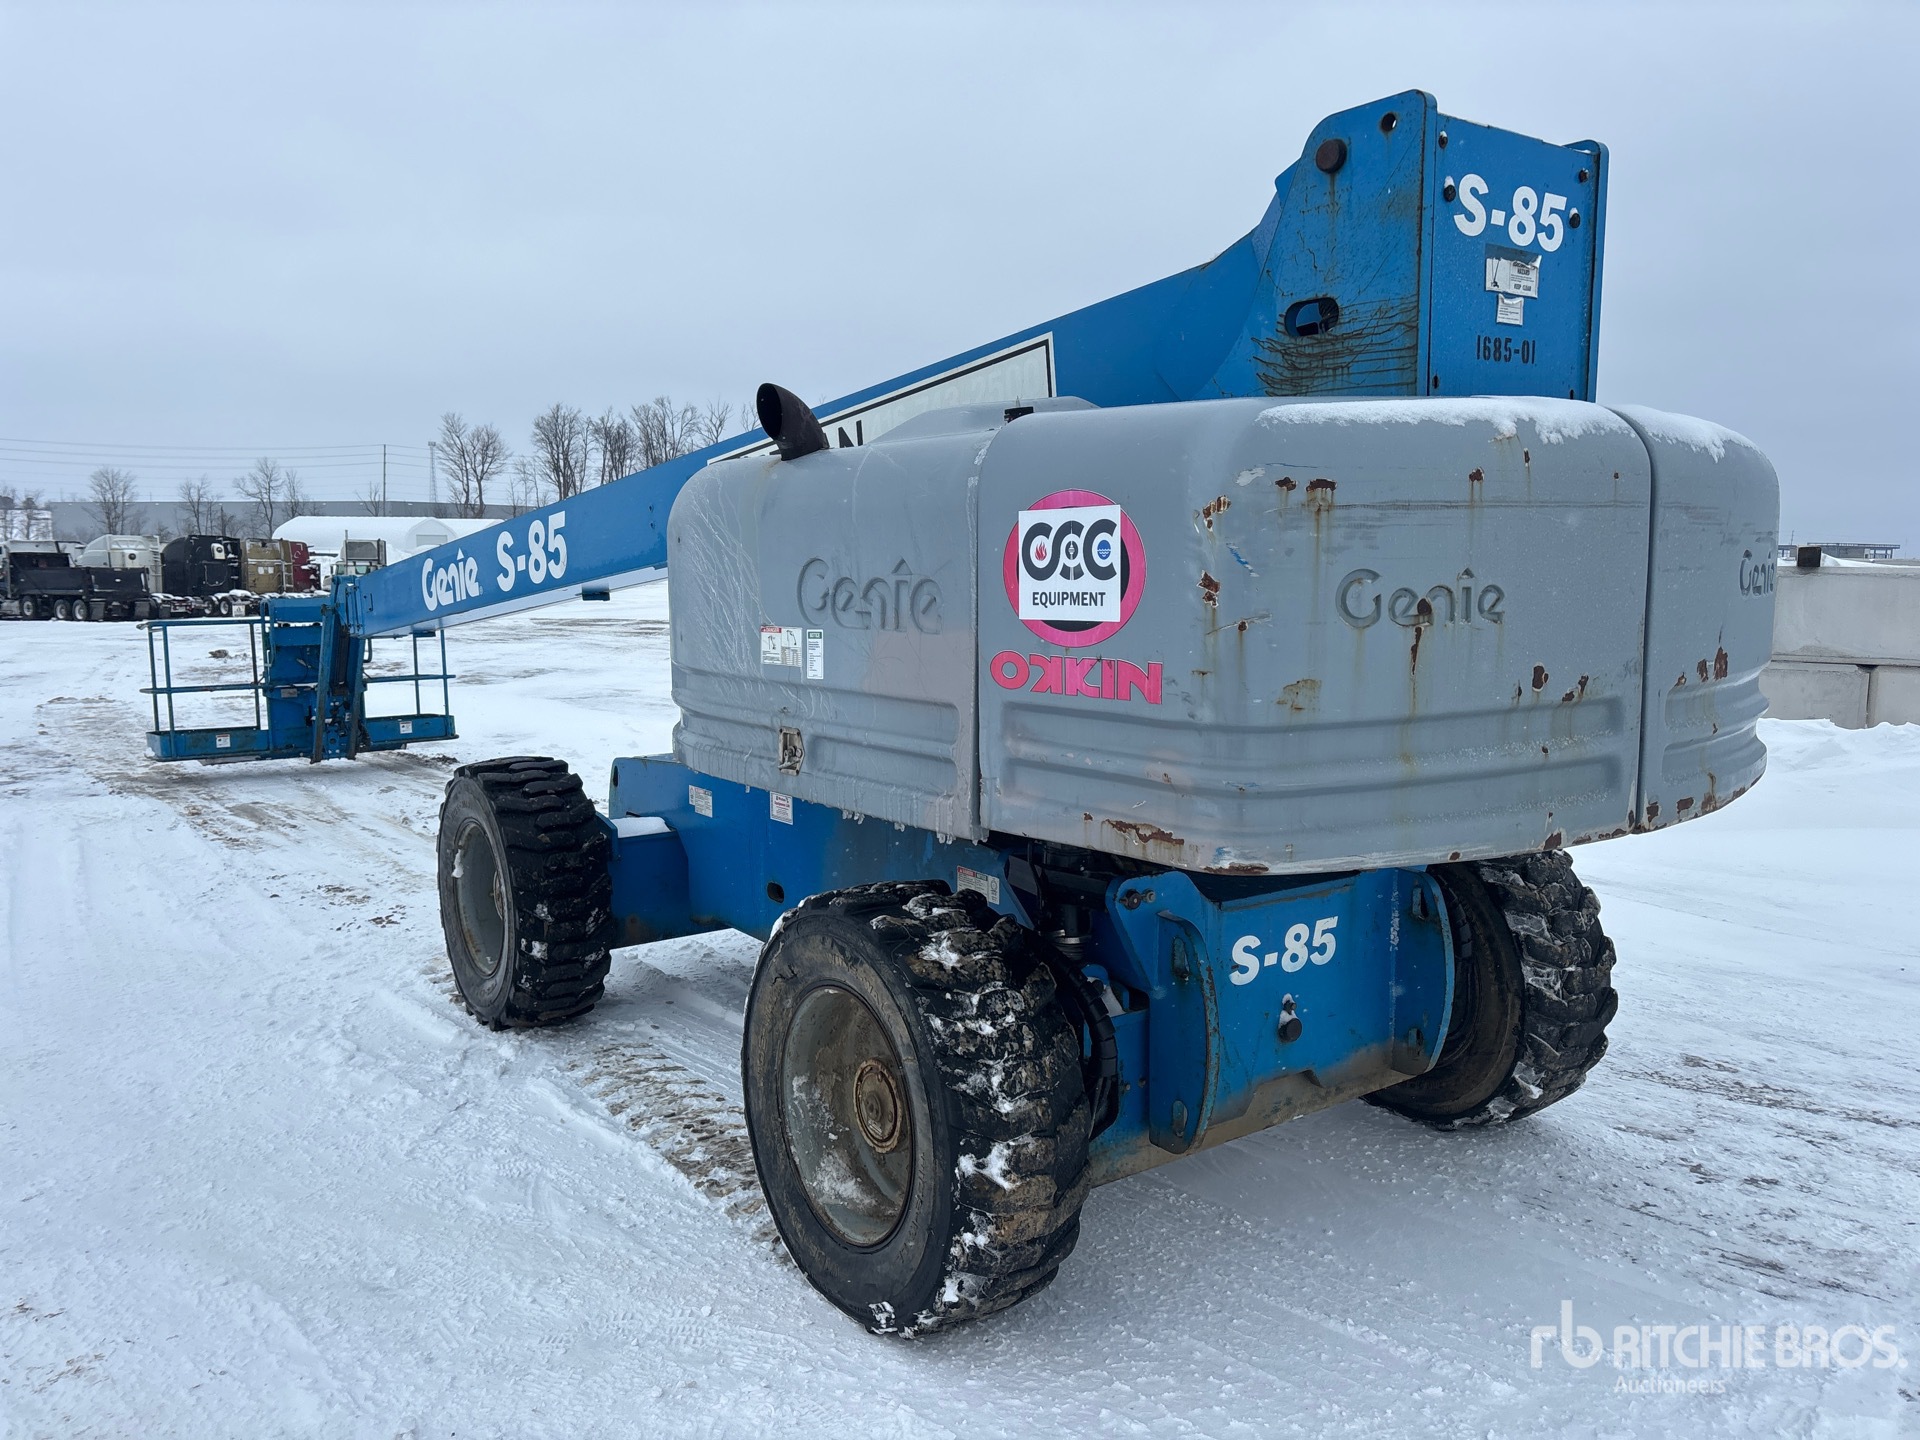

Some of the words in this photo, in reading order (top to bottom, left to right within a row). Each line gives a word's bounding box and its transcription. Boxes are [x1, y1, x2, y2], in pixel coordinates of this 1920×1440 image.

[1453, 173, 1567, 252] S-85
[1477, 335, 1536, 365] 1685-01
[422, 548, 480, 611] Genie
[497, 511, 567, 592] S-85
[797, 557, 943, 635] Genie
[1032, 592, 1106, 609] EQUIPMENT
[1335, 568, 1505, 629] Genie
[1229, 916, 1338, 985] S-85
